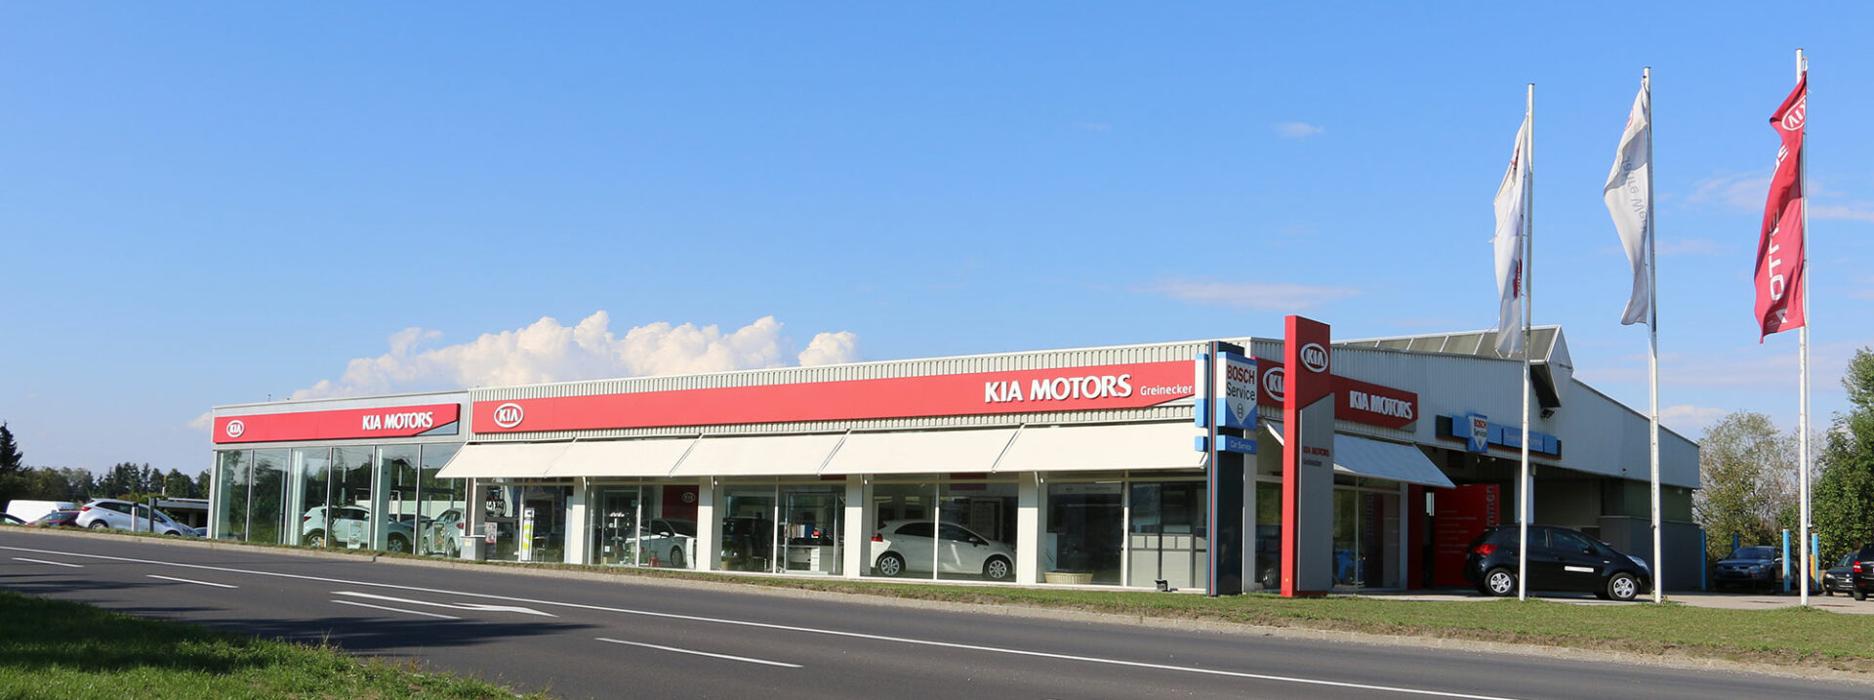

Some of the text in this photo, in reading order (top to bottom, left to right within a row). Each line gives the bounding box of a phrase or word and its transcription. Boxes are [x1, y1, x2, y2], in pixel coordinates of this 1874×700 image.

[1226, 364, 1255, 385] BOSCH
[984, 373, 1193, 403] KIA MOTORS Greinecker
[1226, 382, 1255, 401] Service
[1349, 390, 1413, 420] KIA MOTORS
[362, 411, 433, 430] KIA MOTORS
